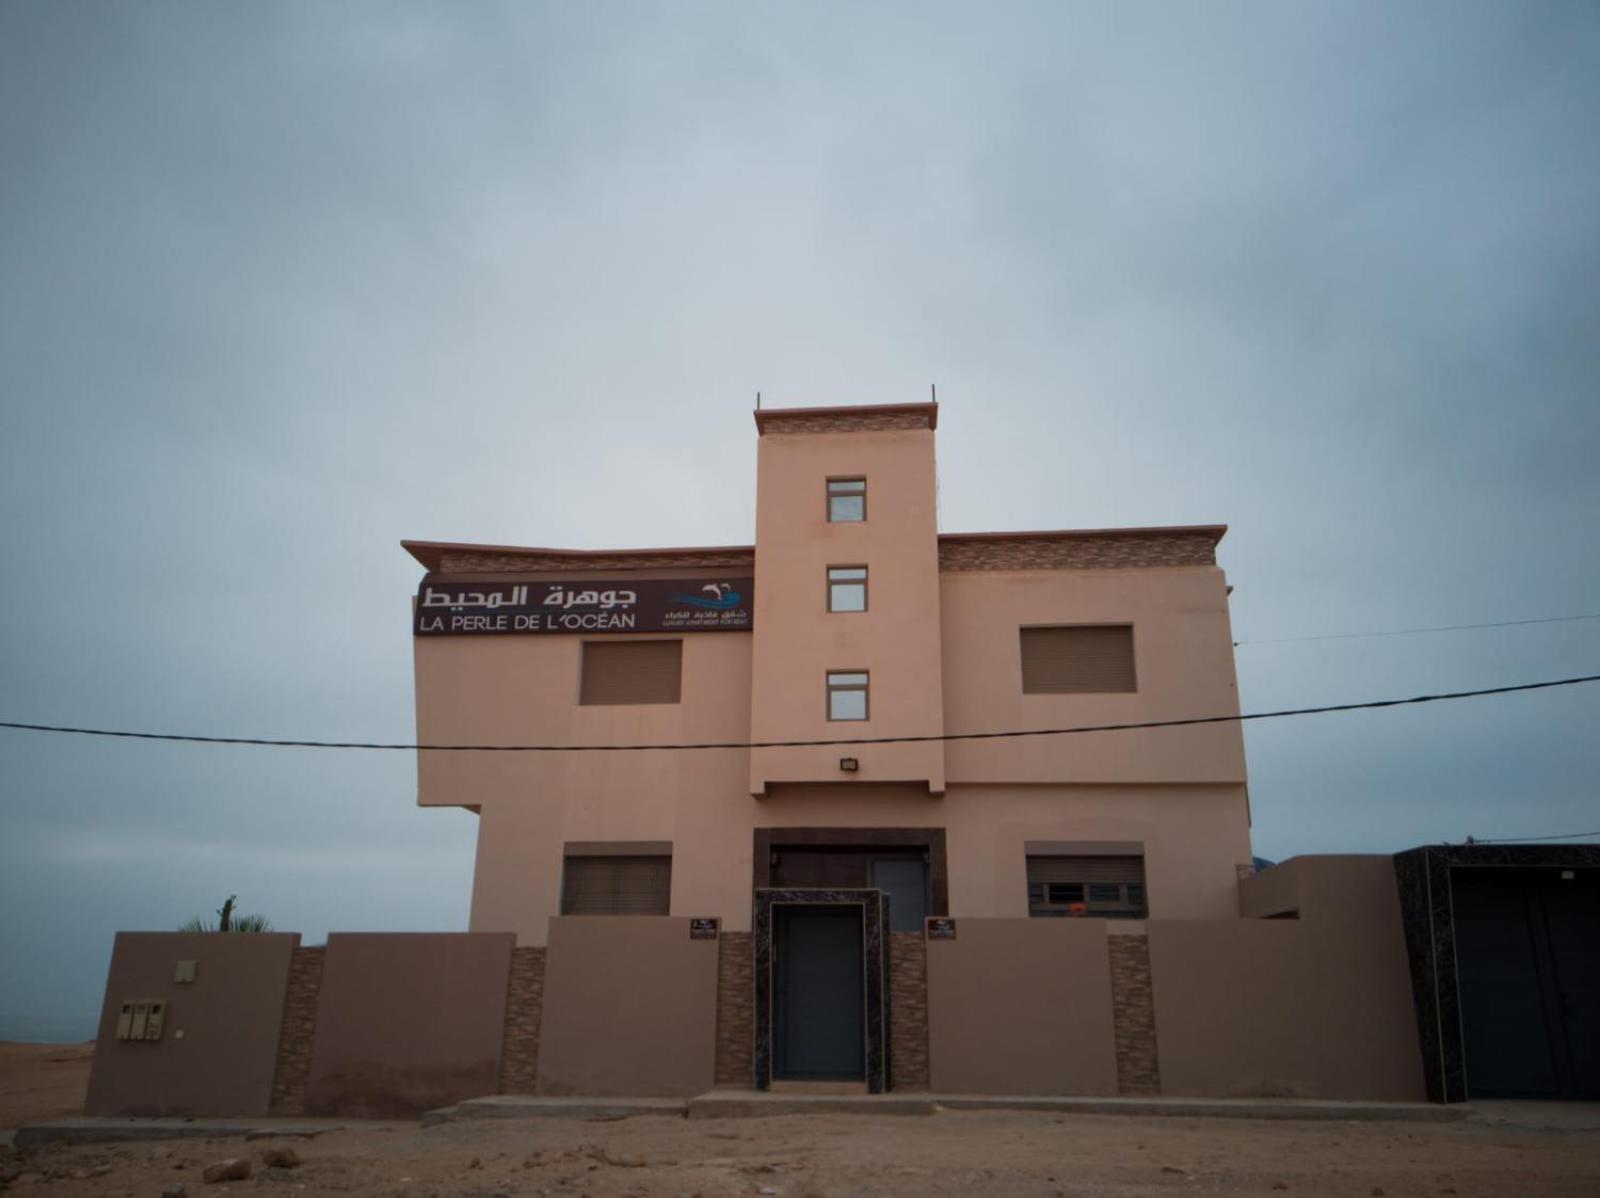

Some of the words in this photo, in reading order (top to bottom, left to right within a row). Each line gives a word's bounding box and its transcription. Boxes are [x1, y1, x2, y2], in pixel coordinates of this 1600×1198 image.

[422, 585, 528, 611] المحيط
[543, 586, 637, 609] جوهرة
[420, 616, 444, 631] LA
[451, 615, 508, 631] PERLE
[514, 614, 540, 630] DE
